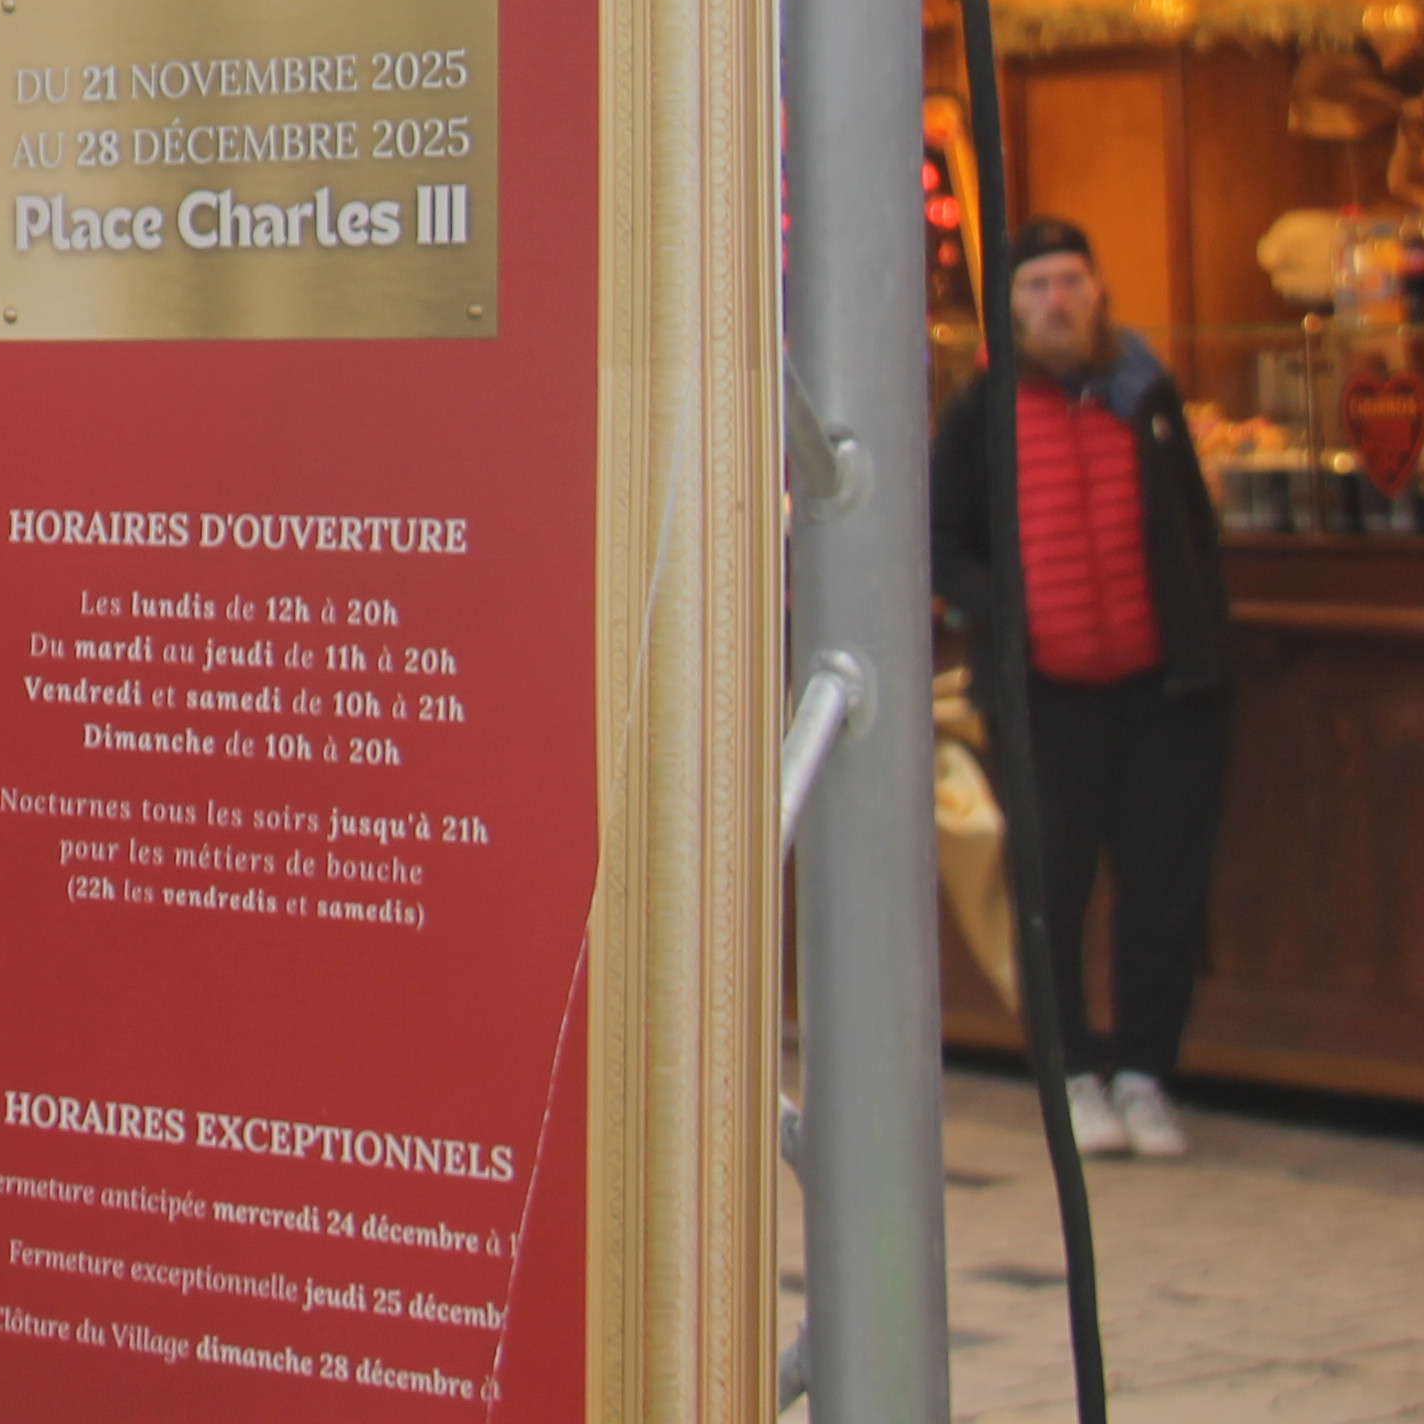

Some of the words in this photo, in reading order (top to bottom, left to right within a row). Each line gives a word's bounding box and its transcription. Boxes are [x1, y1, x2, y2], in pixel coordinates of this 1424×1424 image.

[17, 67, 70, 103] DU
[83, 65, 117, 101] 21
[132, 54, 358, 99] NOVEMBRE
[372, 48, 468, 90] 2025
[13, 132, 64, 168] AU
[77, 130, 119, 166] 28
[133, 118, 359, 165] DÉCEMBRE
[373, 116, 471, 158] 2025
[16, 193, 163, 251] Place
[179, 187, 401, 248] Charles
[418, 185, 467, 243] III
[9, 510, 189, 546] HORAIRES
[200, 514, 466, 553] D'OUVERTURE
[82, 590, 121, 616] Les
[132, 591, 215, 619] lundis
[226, 595, 254, 620] de
[267, 597, 309, 622] 12h
[321, 597, 336, 624] à
[348, 600, 398, 626] 20h
[31, 633, 64, 657] Du
[75, 636, 152, 661] mardi
[163, 644, 194, 663] au
[202, 638, 273, 671] jeudi
[285, 642, 313, 668] de
[326, 645, 366, 670] 11h
[378, 645, 393, 672] à
[405, 648, 456, 674] 20h
[24, 677, 141, 706] Vendredi
[152, 686, 174, 708] et
[187, 687, 281, 713] samedi
[293, 688, 321, 715] de
[334, 691, 380, 718] 10h
[392, 693, 407, 719] à
[419, 695, 464, 722] 21h
[84, 723, 214, 754] Dimanche
[226, 730, 254, 757] de
[266, 734, 311, 760] 10h
[323, 736, 338, 762] à
[350, 738, 400, 765] 20h
[1, 788, 131, 819] Nocturnes
[142, 800, 196, 823] tous
[208, 800, 242, 826] les
[254, 805, 319, 832] soirs
[327, 808, 430, 845] jusqu'à
[443, 816, 488, 843] 21h
[60, 840, 119, 865] pour
[130, 838, 163, 865] les
[175, 843, 274, 873] métiers
[286, 849, 315, 876] de
[328, 852, 422, 884] bouche
[68, 876, 115, 904] (22h
[124, 879, 154, 903] les
[163, 885, 277, 912] vendredis
[286, 896, 307, 915] et
[318, 899, 424, 929] samedis)
[5, 1091, 185, 1143] HORAIRES
[197, 1112, 513, 1181] EXCEPTIONNELS
[101, 1186, 206, 1222] anticipée
[213, 1202, 320, 1233] mercredi
[327, 1210, 354, 1237] 24
[362, 1214, 478, 1253] décembre
[486, 1229, 501, 1256] à
[10, 1239, 124, 1278] Fermeture
[131, 1262, 297, 1301] exceptionnelle
[303, 1278, 366, 1311] jeudi
[373, 1288, 402, 1315] 25
[76, 1318, 105, 1345] du
[112, 1323, 189, 1362] Village
[196, 1335, 312, 1375] dimanche
[320, 1353, 349, 1380] 28
[356, 1358, 472, 1399] décembre
